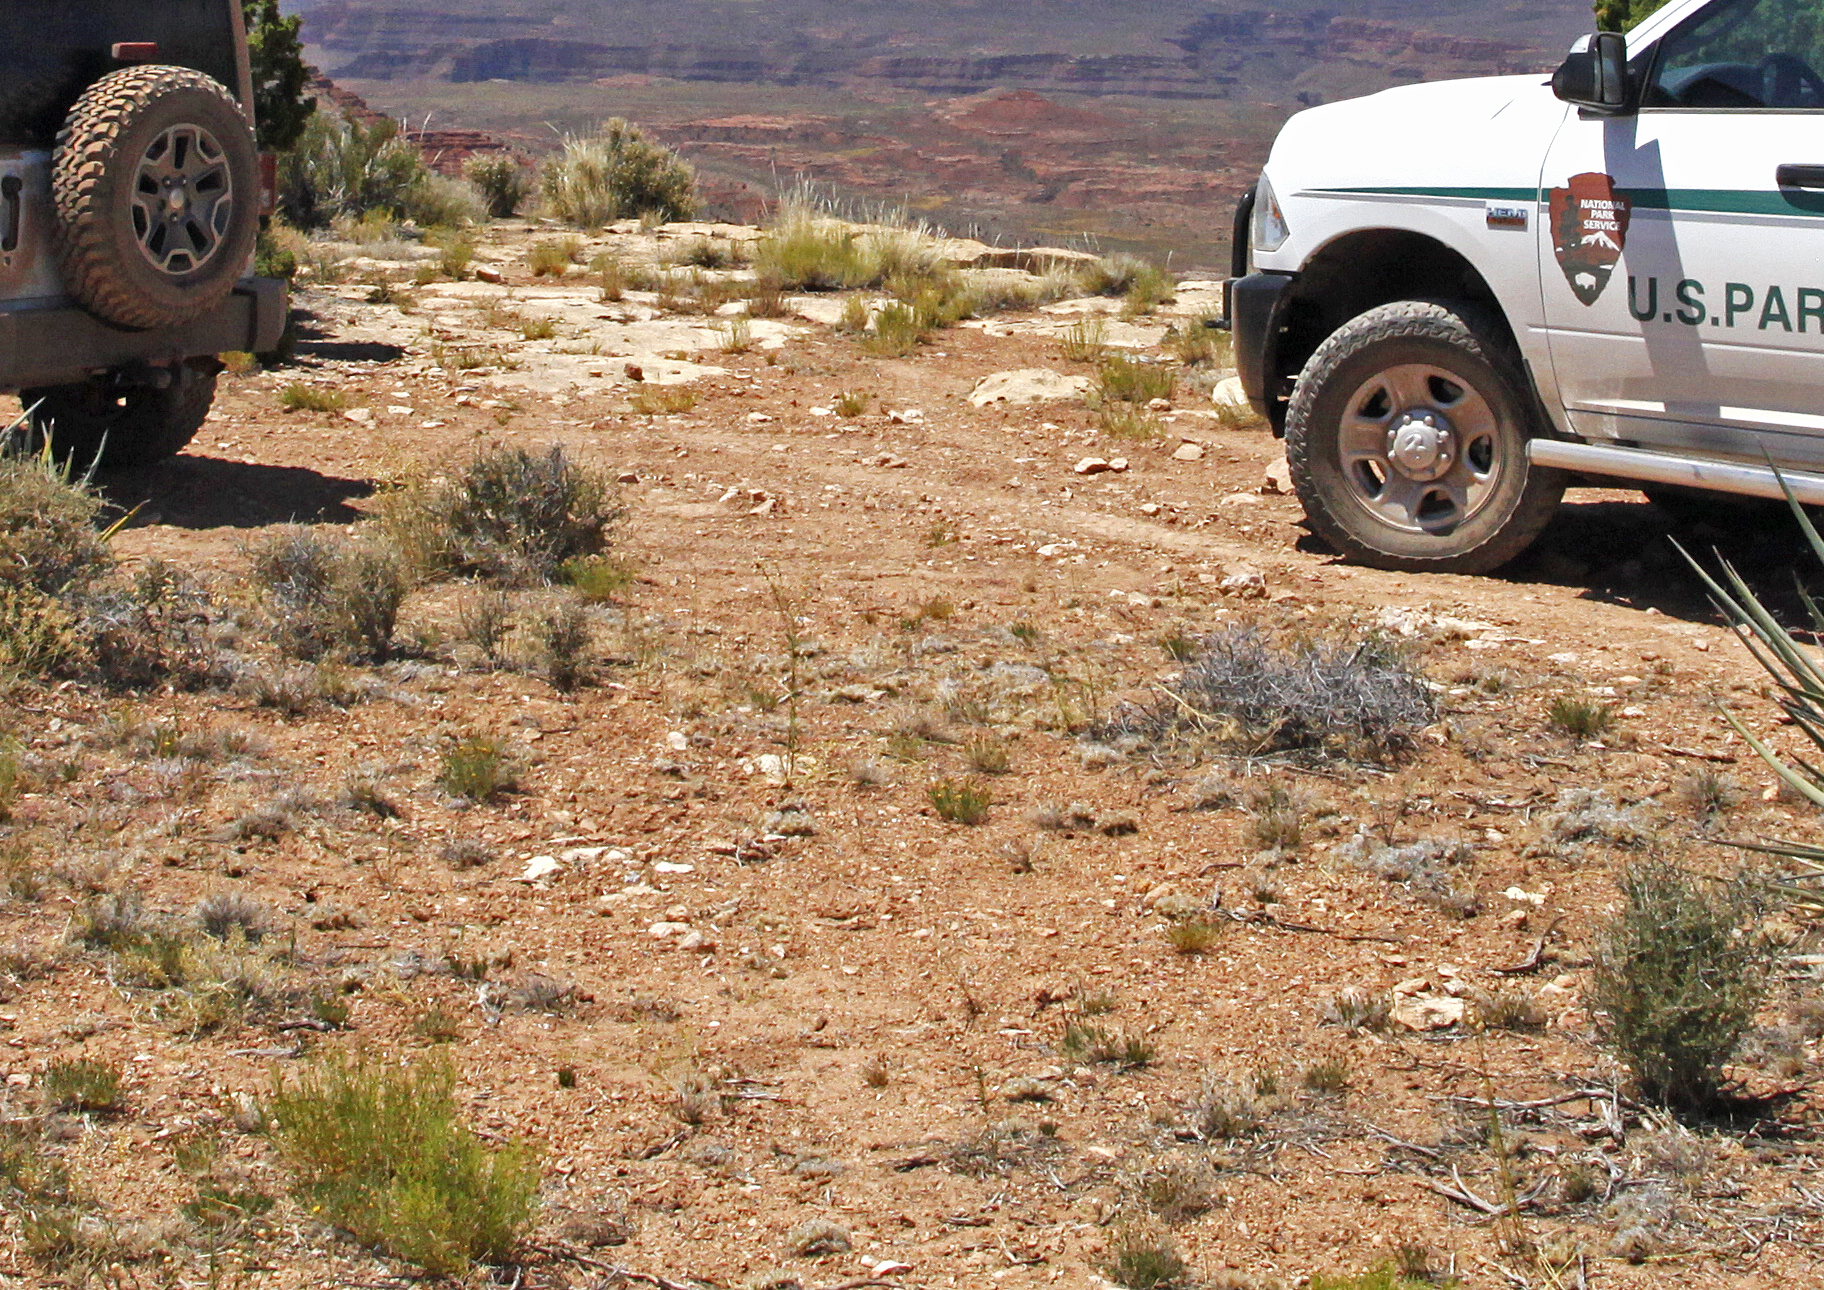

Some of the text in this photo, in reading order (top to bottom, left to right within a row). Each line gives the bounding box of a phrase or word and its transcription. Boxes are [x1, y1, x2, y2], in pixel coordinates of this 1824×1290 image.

[1580, 199, 1625, 210] NATIONAL
[1591, 209, 1615, 220] PARK
[1583, 219, 1620, 231] SERVICE
